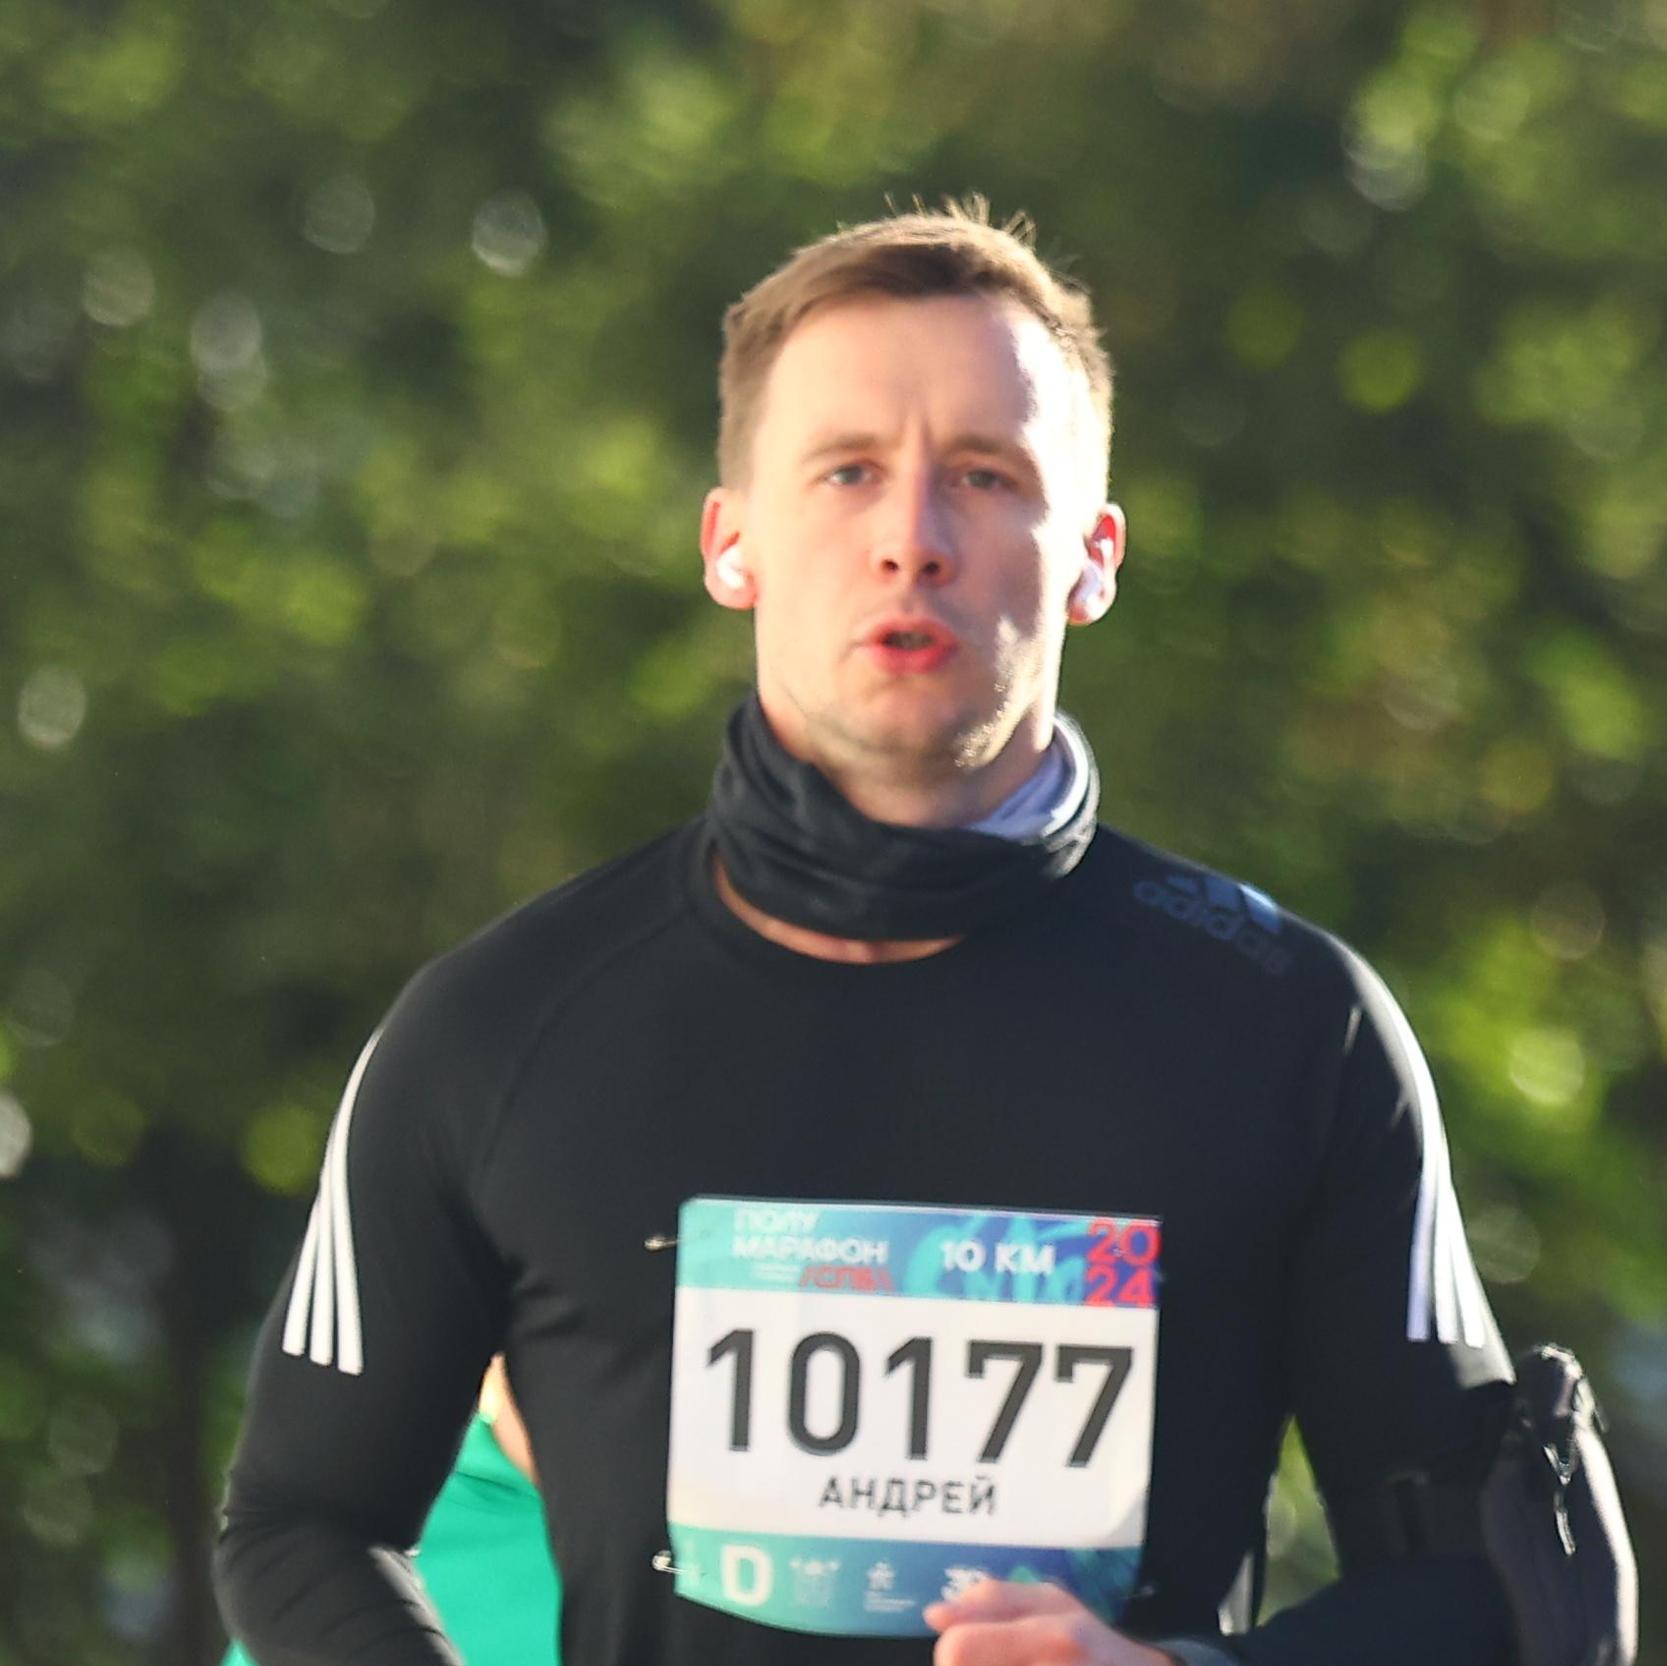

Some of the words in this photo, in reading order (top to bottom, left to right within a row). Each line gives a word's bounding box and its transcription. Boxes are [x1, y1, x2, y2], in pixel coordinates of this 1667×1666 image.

[732, 1236, 890, 1265] МАРАФОН
[941, 1239, 986, 1273] 10
[994, 1241, 1057, 1275] КМ
[1088, 1217, 1161, 1266] 20
[1085, 1264, 1155, 1308] 24
[706, 1328, 1134, 1468] 10177
[818, 1474, 998, 1516] АНДРЕЙ
[721, 1543, 774, 1606] D
